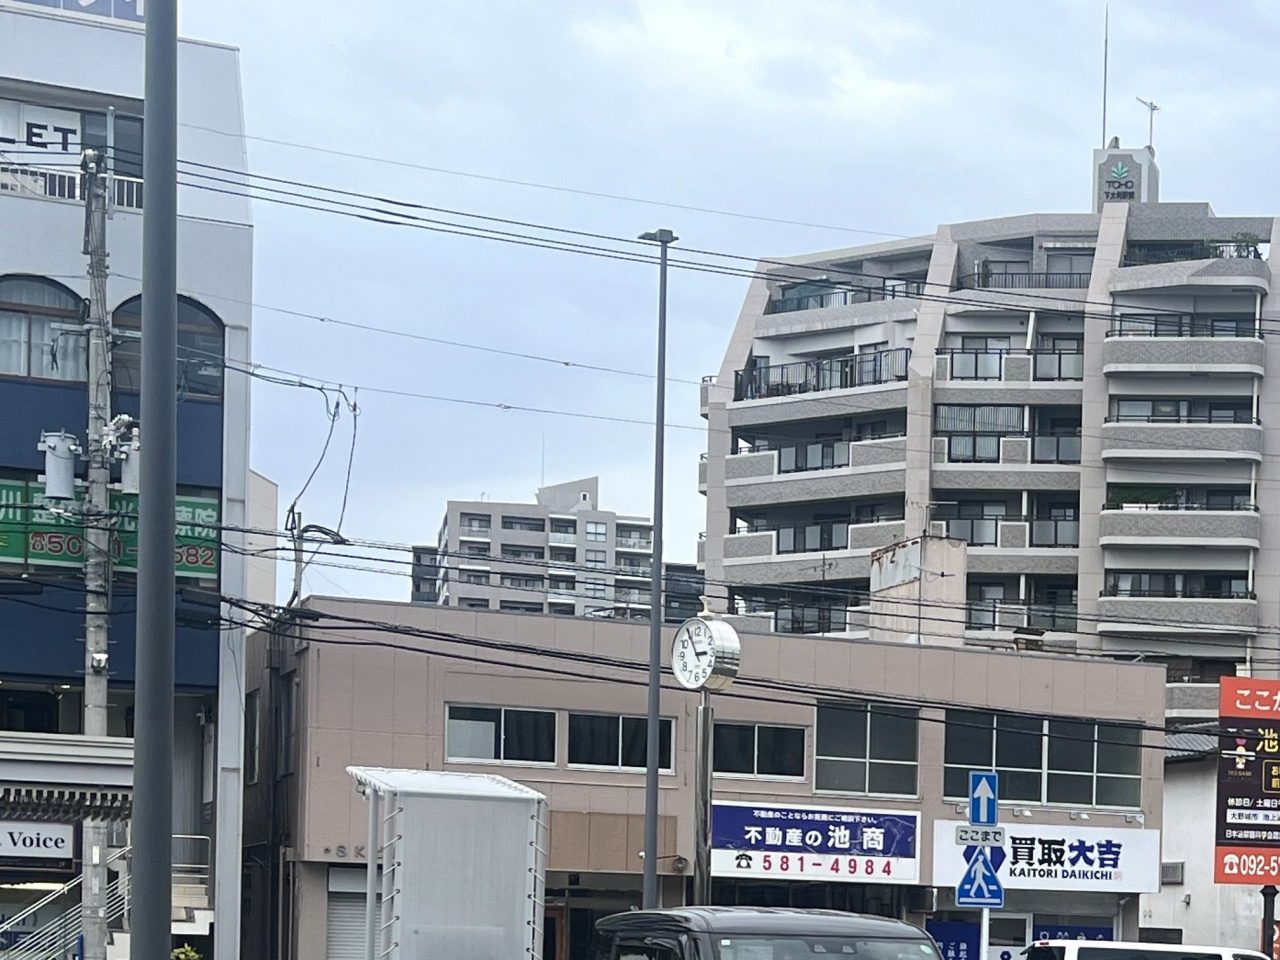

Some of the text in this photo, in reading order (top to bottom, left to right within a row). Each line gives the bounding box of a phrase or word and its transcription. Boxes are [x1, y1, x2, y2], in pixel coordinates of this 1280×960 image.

[7, 831, 66, 849] Voice
[959, 829, 1002, 842] ここまで
[1009, 836, 1122, 868] 買取大吉
[762, 855, 892, 876] 581-4984
[1009, 867, 1112, 880] KAITORI DAIKICHI
